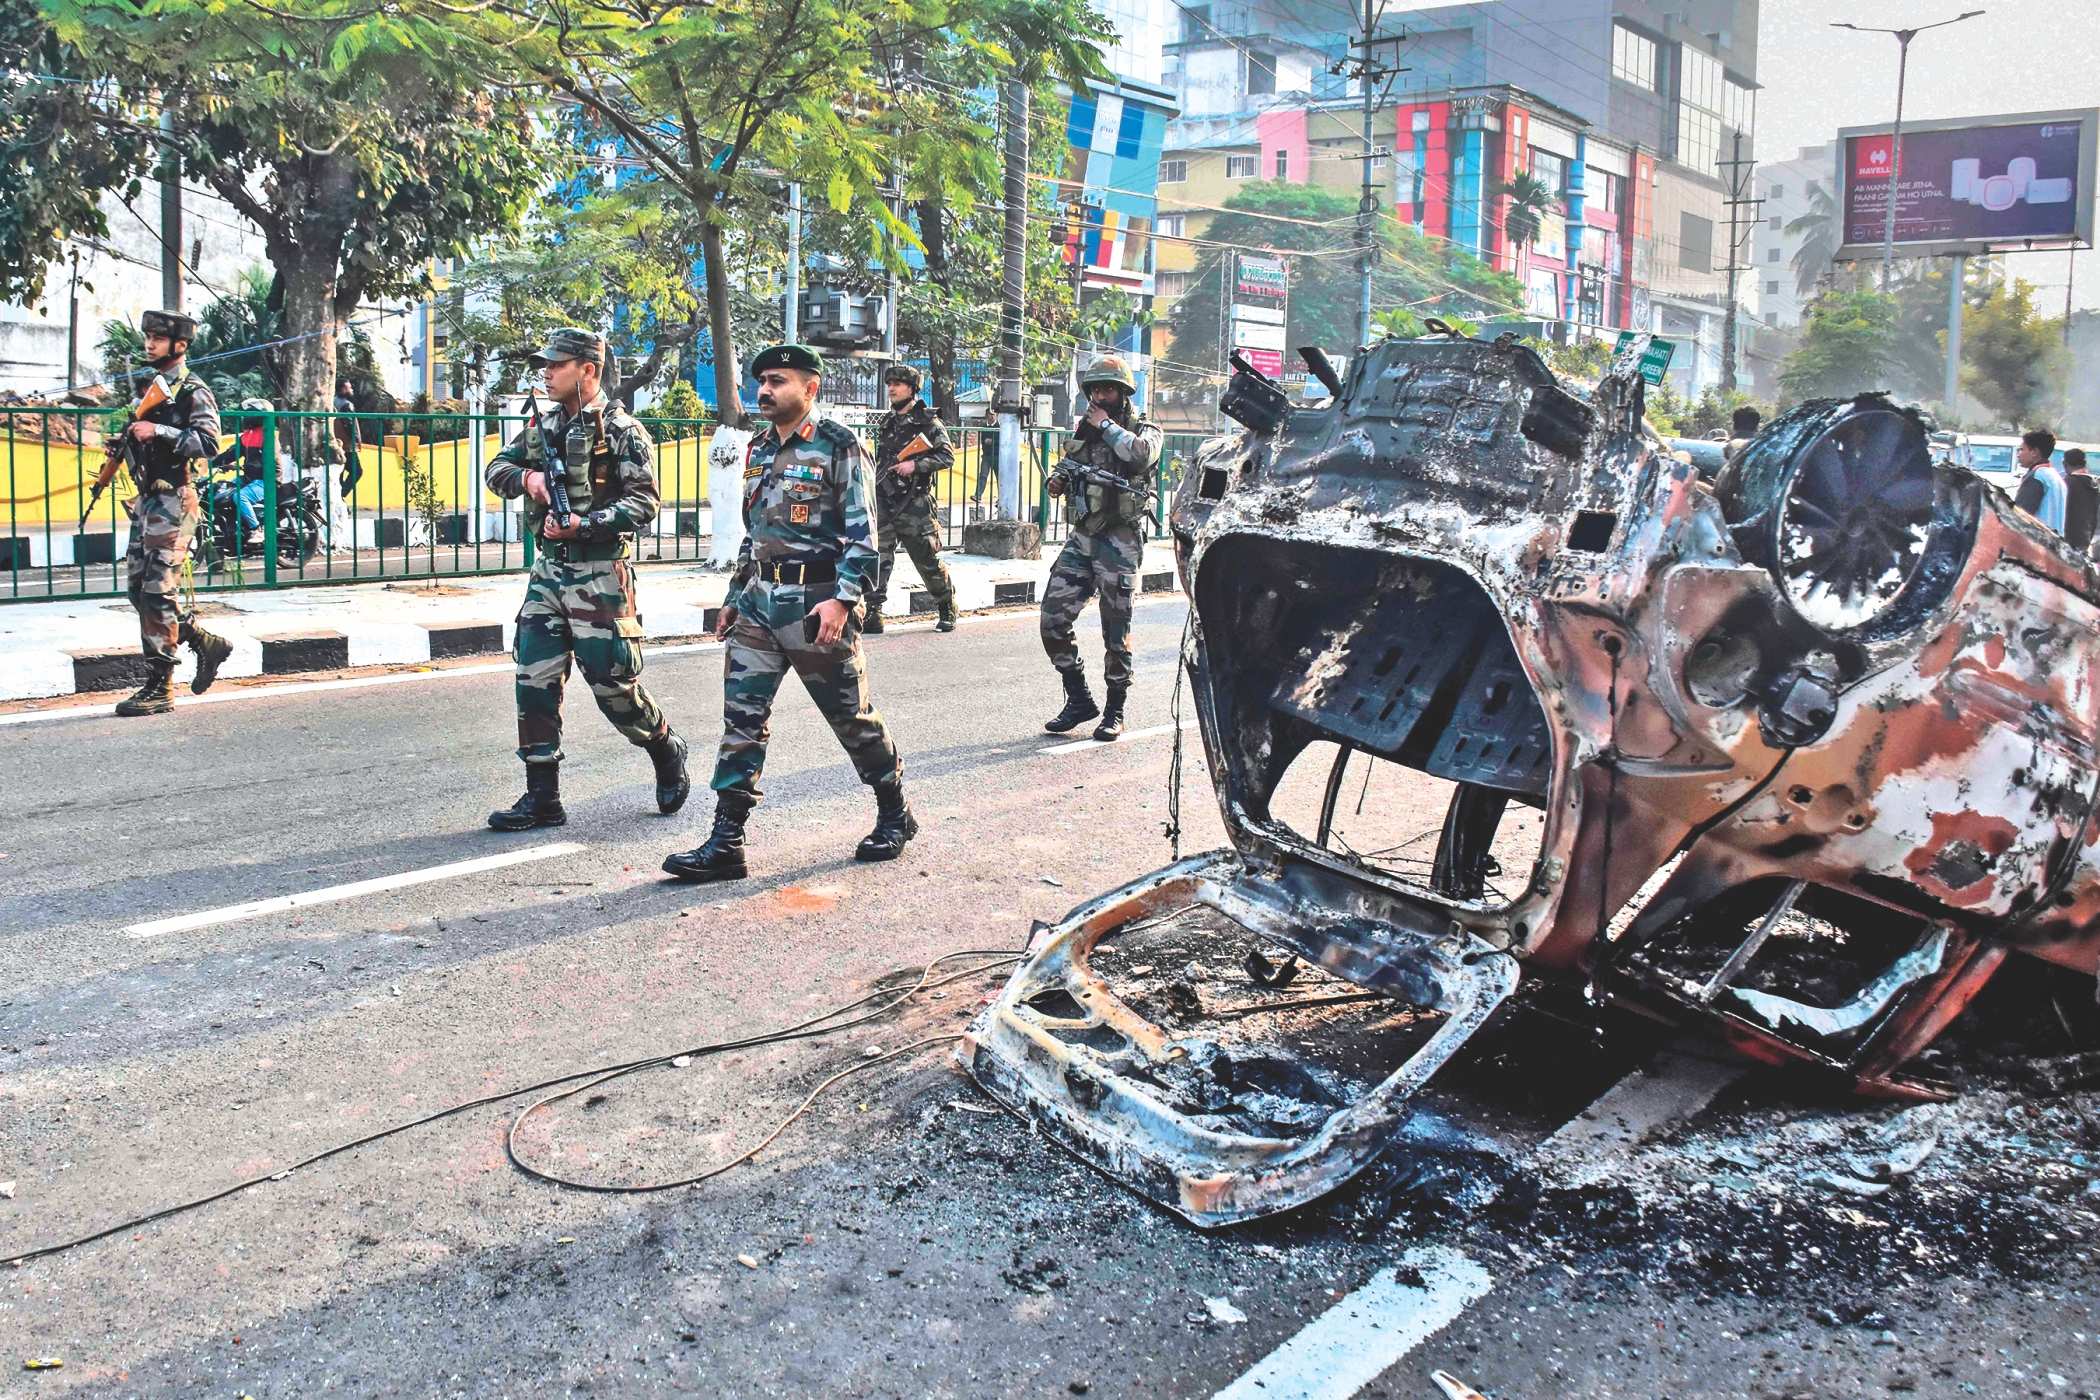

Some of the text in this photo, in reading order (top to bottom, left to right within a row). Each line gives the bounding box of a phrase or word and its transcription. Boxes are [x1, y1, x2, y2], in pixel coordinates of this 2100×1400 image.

[1912, 181, 1935, 189] JITNA,
[1855, 194, 1876, 202] PAANI
[1878, 192, 1906, 200] GAAM
[1921, 190, 1944, 198] UTNA.
[1641, 363, 1663, 376] GREEN
[1285, 373, 1295, 381] BAR
